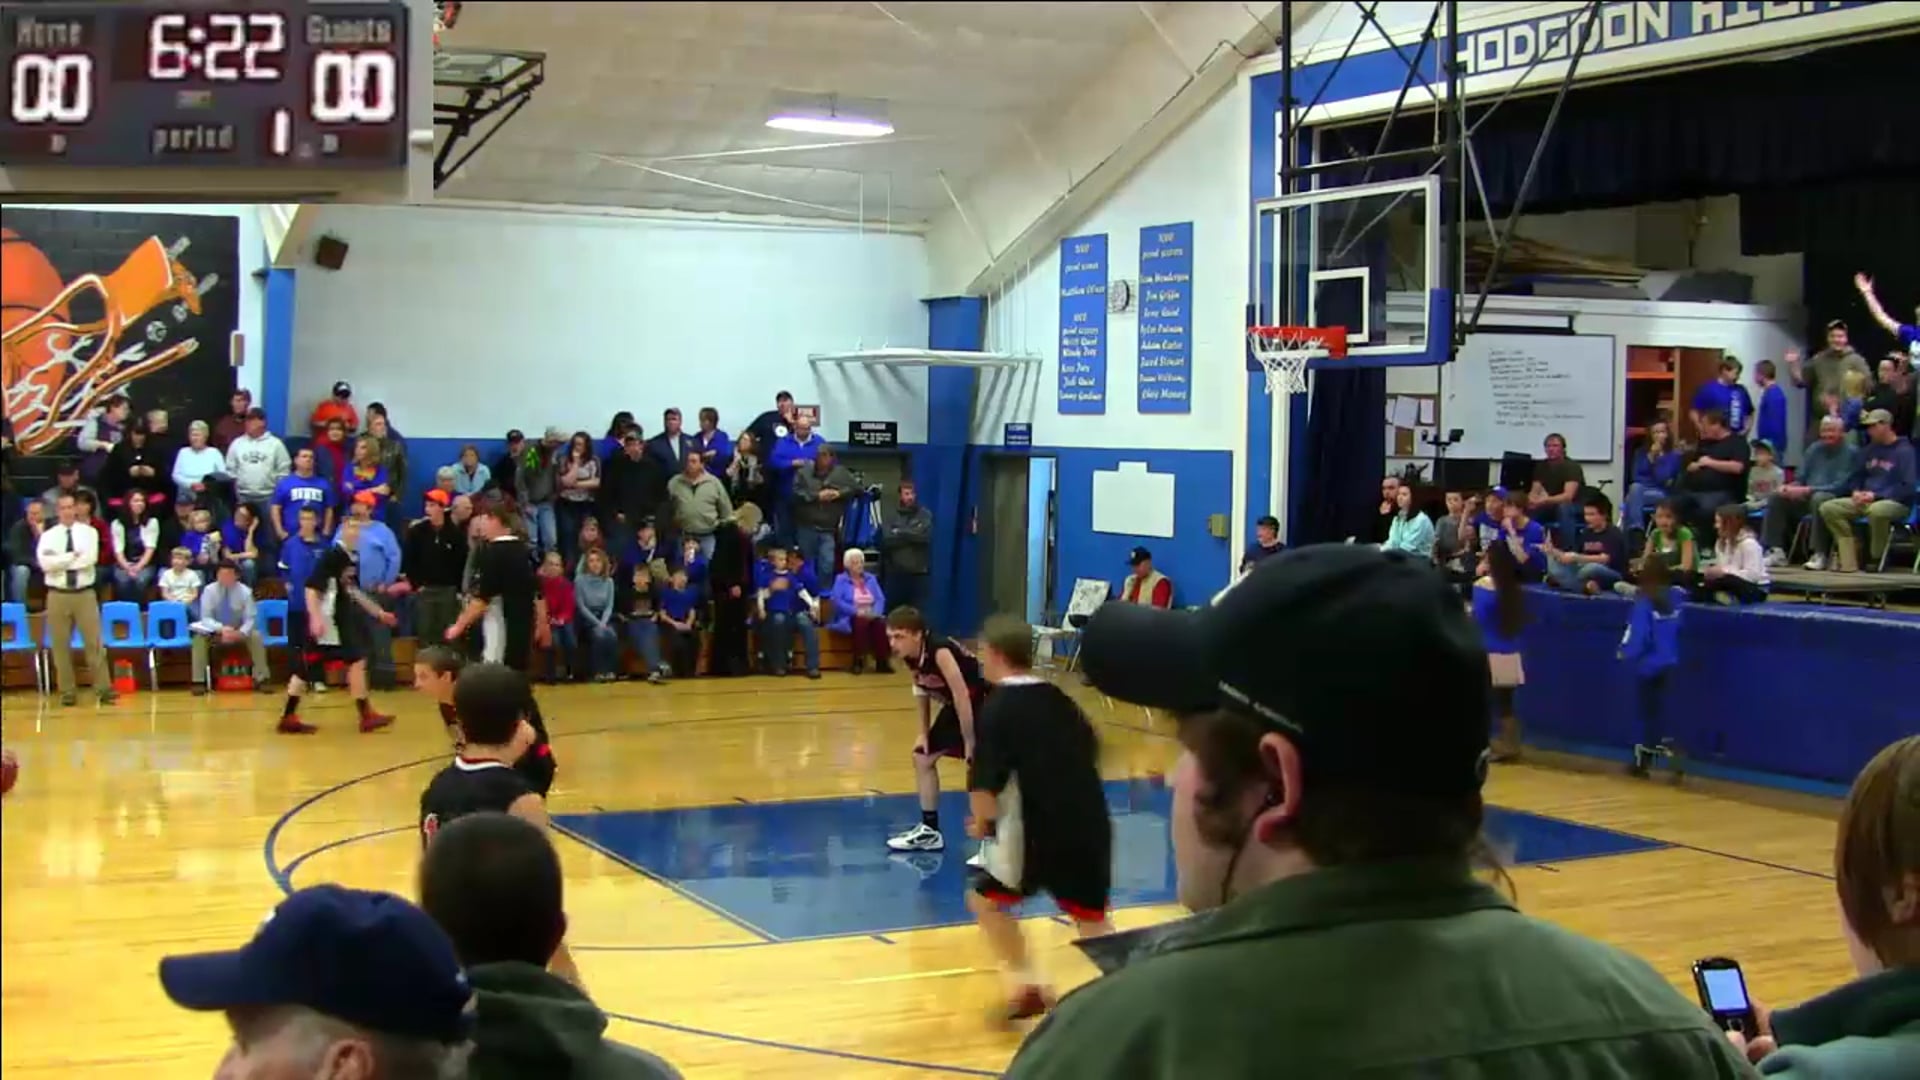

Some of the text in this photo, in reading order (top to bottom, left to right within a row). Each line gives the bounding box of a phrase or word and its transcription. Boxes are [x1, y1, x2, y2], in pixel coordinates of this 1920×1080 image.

[16, 17, 82, 47] Home
[149, 14, 285, 79] 6:22
[306, 15, 391, 44] Guests
[1456, 1, 1841, 76] HODGDON HI
[12, 54, 92, 122] 00
[312, 51, 395, 122] 00
[152, 109, 290, 155] period 1
